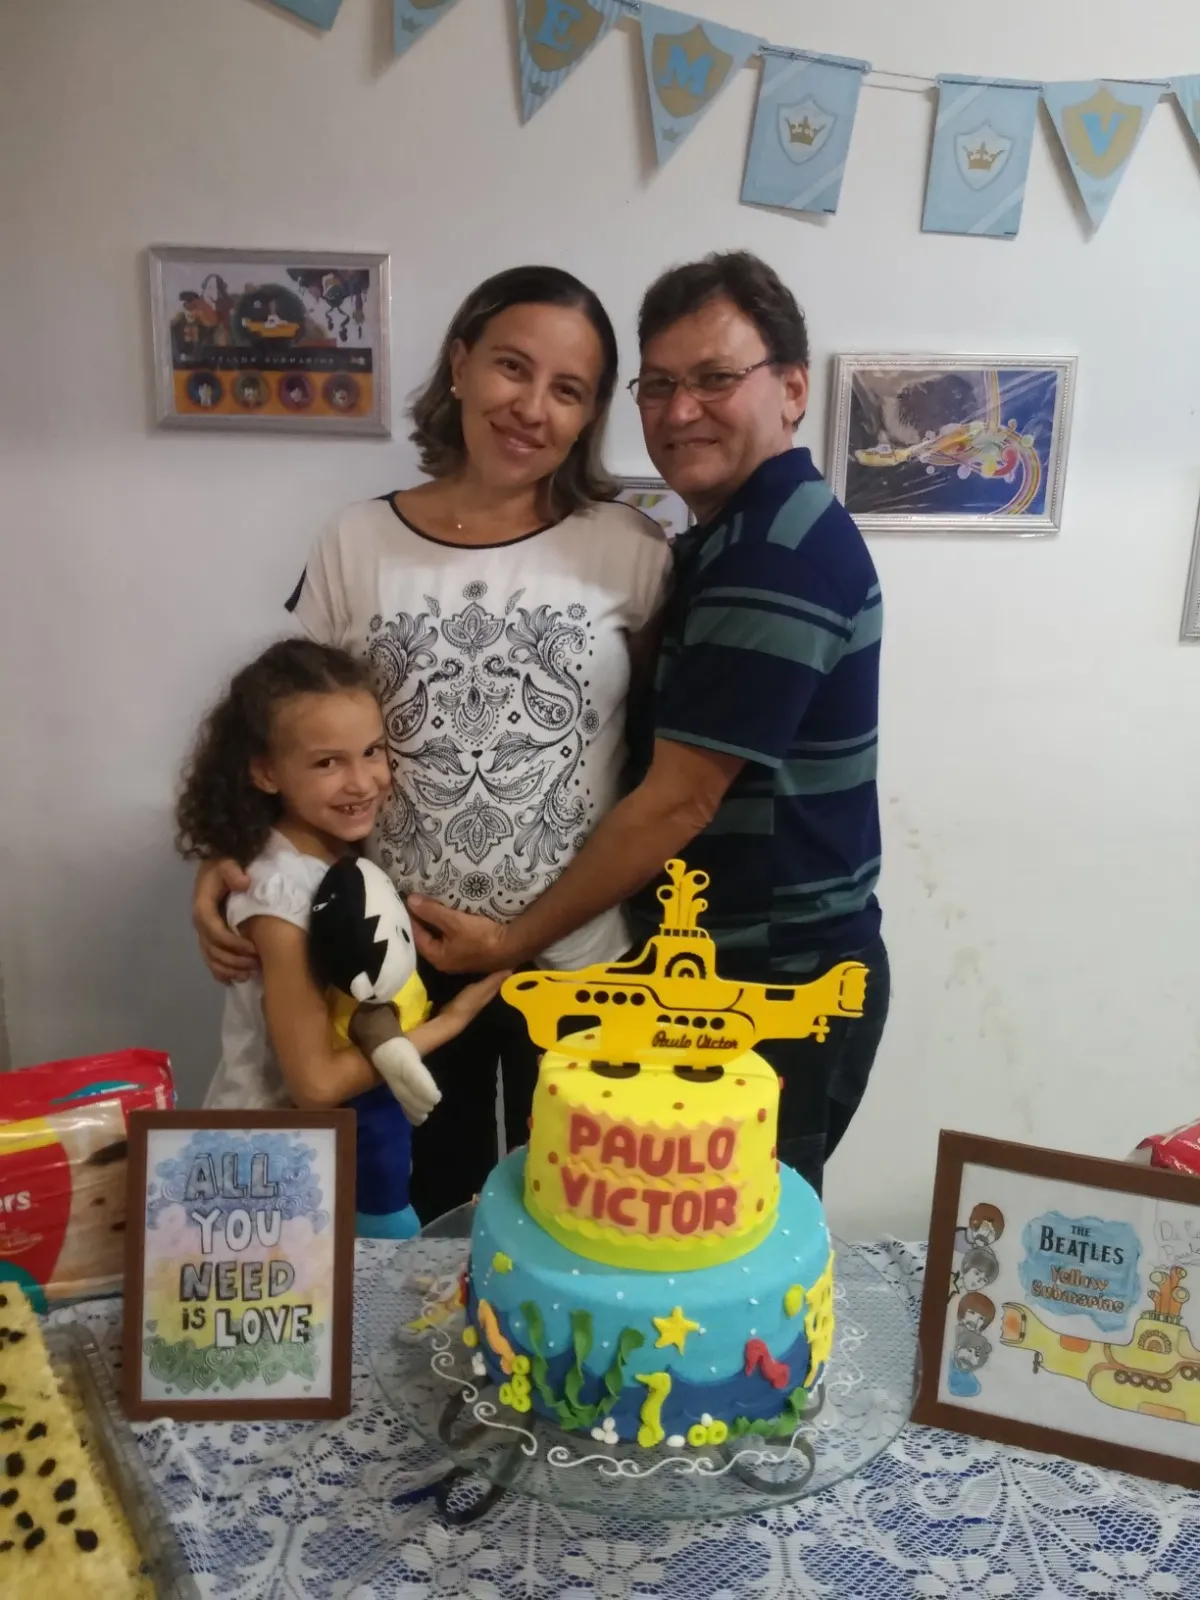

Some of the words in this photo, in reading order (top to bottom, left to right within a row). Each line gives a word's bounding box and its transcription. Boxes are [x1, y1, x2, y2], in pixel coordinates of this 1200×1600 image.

[536, 0, 582, 52] E
[660, 45, 713, 96] M
[1080, 112, 1127, 157] V
[652, 1030, 692, 1048] Paulo
[696, 1033, 739, 1050] Victor
[570, 1113, 735, 1177] PAULO
[184, 1152, 280, 1202] ALL
[561, 1165, 738, 1235] VICTOR
[192, 1207, 282, 1254] YOU
[1040, 1225, 1125, 1265] BEATLES
[1071, 1225, 1092, 1238] THE
[180, 1260, 296, 1302] NEED
[1031, 1279, 1125, 1314] Submarine
[1051, 1264, 1110, 1292] Yellow
[215, 1304, 313, 1349] LOVE
